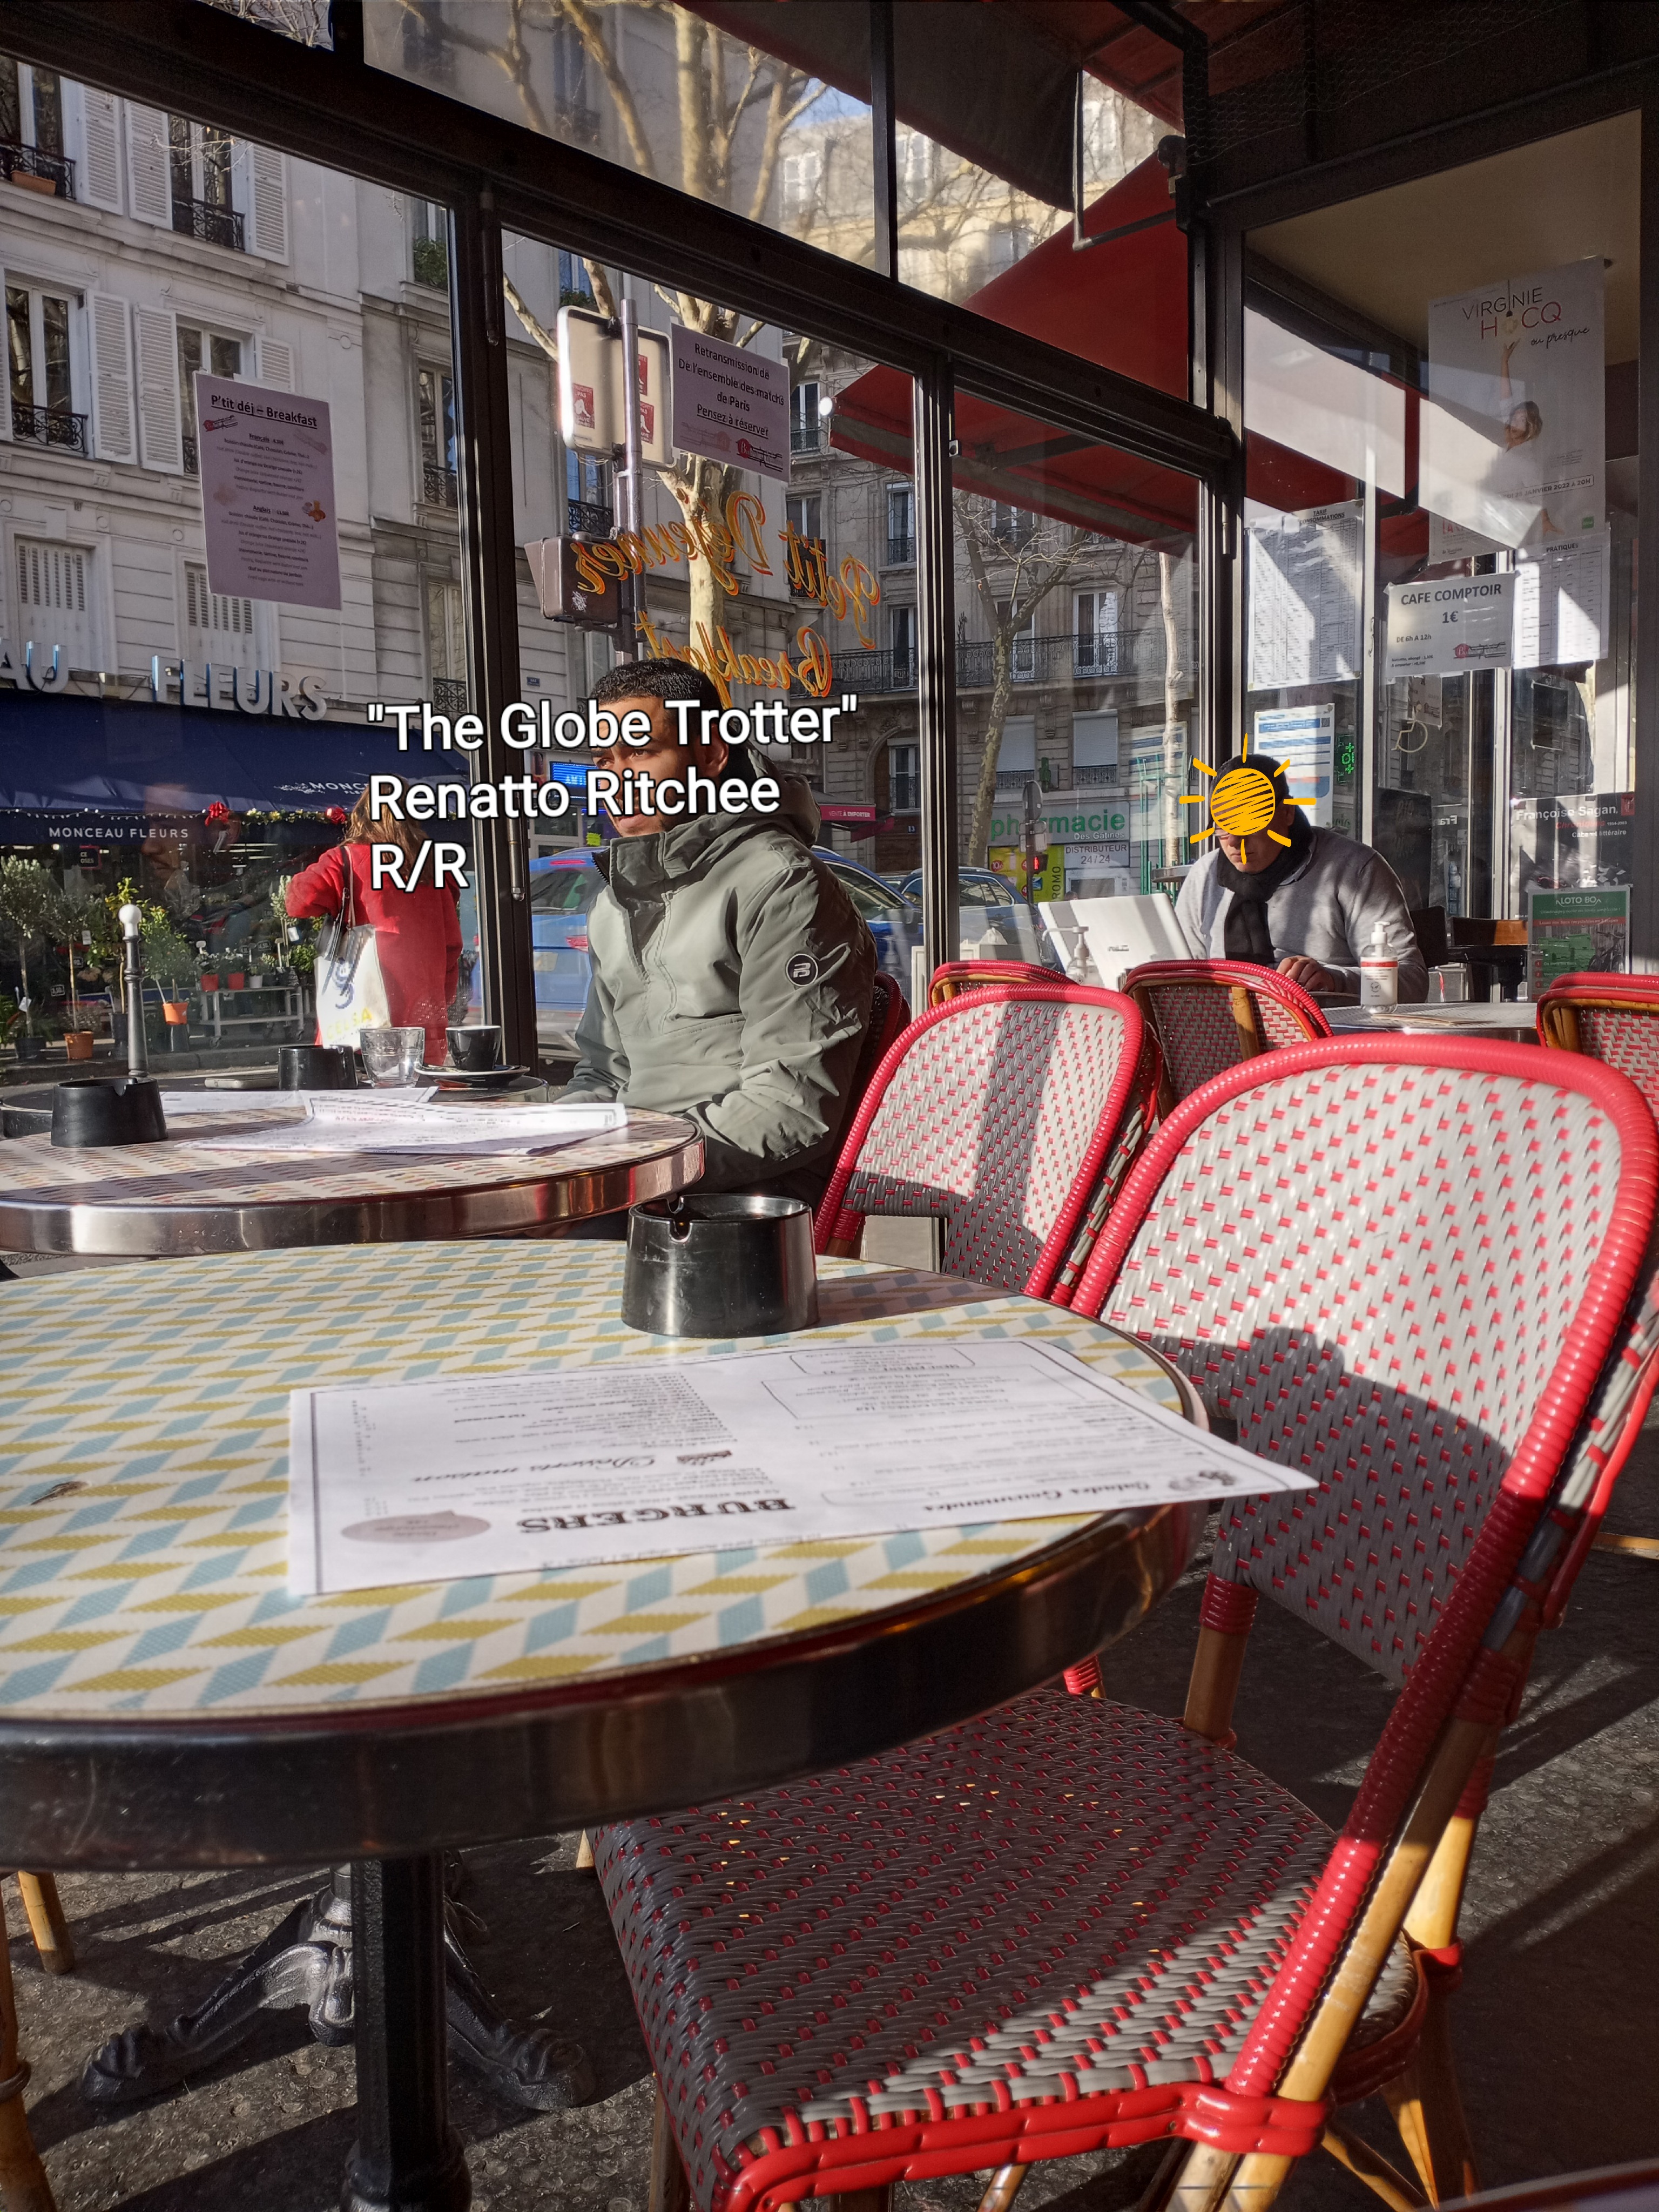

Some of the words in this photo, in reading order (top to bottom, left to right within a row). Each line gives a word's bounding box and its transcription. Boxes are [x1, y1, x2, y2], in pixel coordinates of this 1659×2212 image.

[1462, 287, 1543, 320] VIRGINIE
[1546, 327, 1590, 349] presque
[694, 343, 759, 375] Retransmission
[760, 368, 770, 380] de
[679, 358, 691, 372] De
[741, 381, 754, 395] des
[756, 388, 784, 406] matchs
[237, 400, 254, 415] déj
[266, 407, 318, 427] Breakfast
[717, 392, 727, 404] de
[730, 395, 750, 412] Paris
[697, 403, 726, 423] Pensez
[729, 412, 733, 425] à
[736, 420, 769, 437] réserver
[1554, 482, 1570, 491] 2022
[1577, 478, 1591, 486] 20H
[1401, 592, 1431, 605] CAFE
[1434, 584, 1501, 602] COMPTOIR
[1442, 610, 1459, 624] 1€
[152, 655, 327, 721] FLEURS
[309, 782, 368, 791] MONC
[991, 809, 1125, 841] phmacie
[1515, 808, 1575, 821] Françoise
[49, 827, 124, 838] MONCEAU
[130, 828, 188, 838] FLEURS
[1065, 844, 1127, 854] DISTRIBUTEUR
[1052, 866, 1062, 901] ROMO
[516, 1498, 795, 1534] BURGERS
